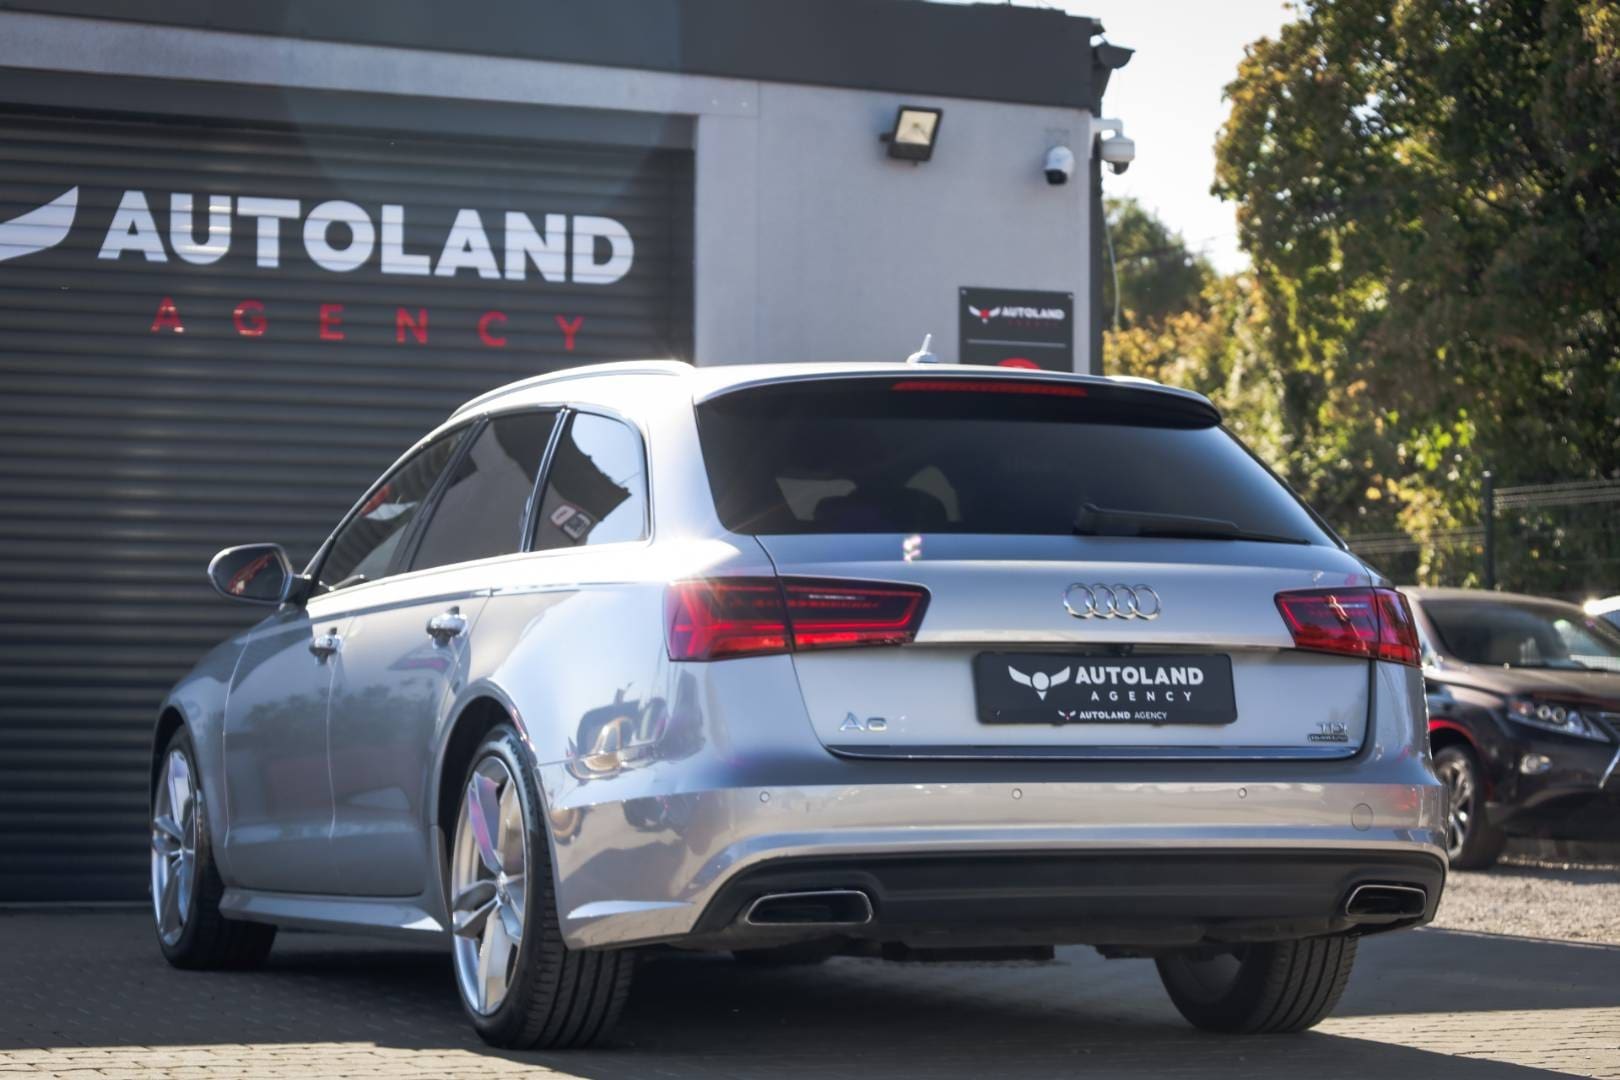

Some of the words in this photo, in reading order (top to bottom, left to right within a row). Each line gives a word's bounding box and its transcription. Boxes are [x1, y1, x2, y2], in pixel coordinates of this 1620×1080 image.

[98, 190, 634, 285] AUTOLAND
[1001, 305, 1065, 320] AUTOLAND
[151, 297, 584, 350] AGENCY
[1075, 666, 1204, 685] AUTOLAND
[1091, 691, 1192, 702] AGENCY
[1079, 711, 1131, 720] AUTOLAND
[1134, 711, 1168, 720] AGENCY
